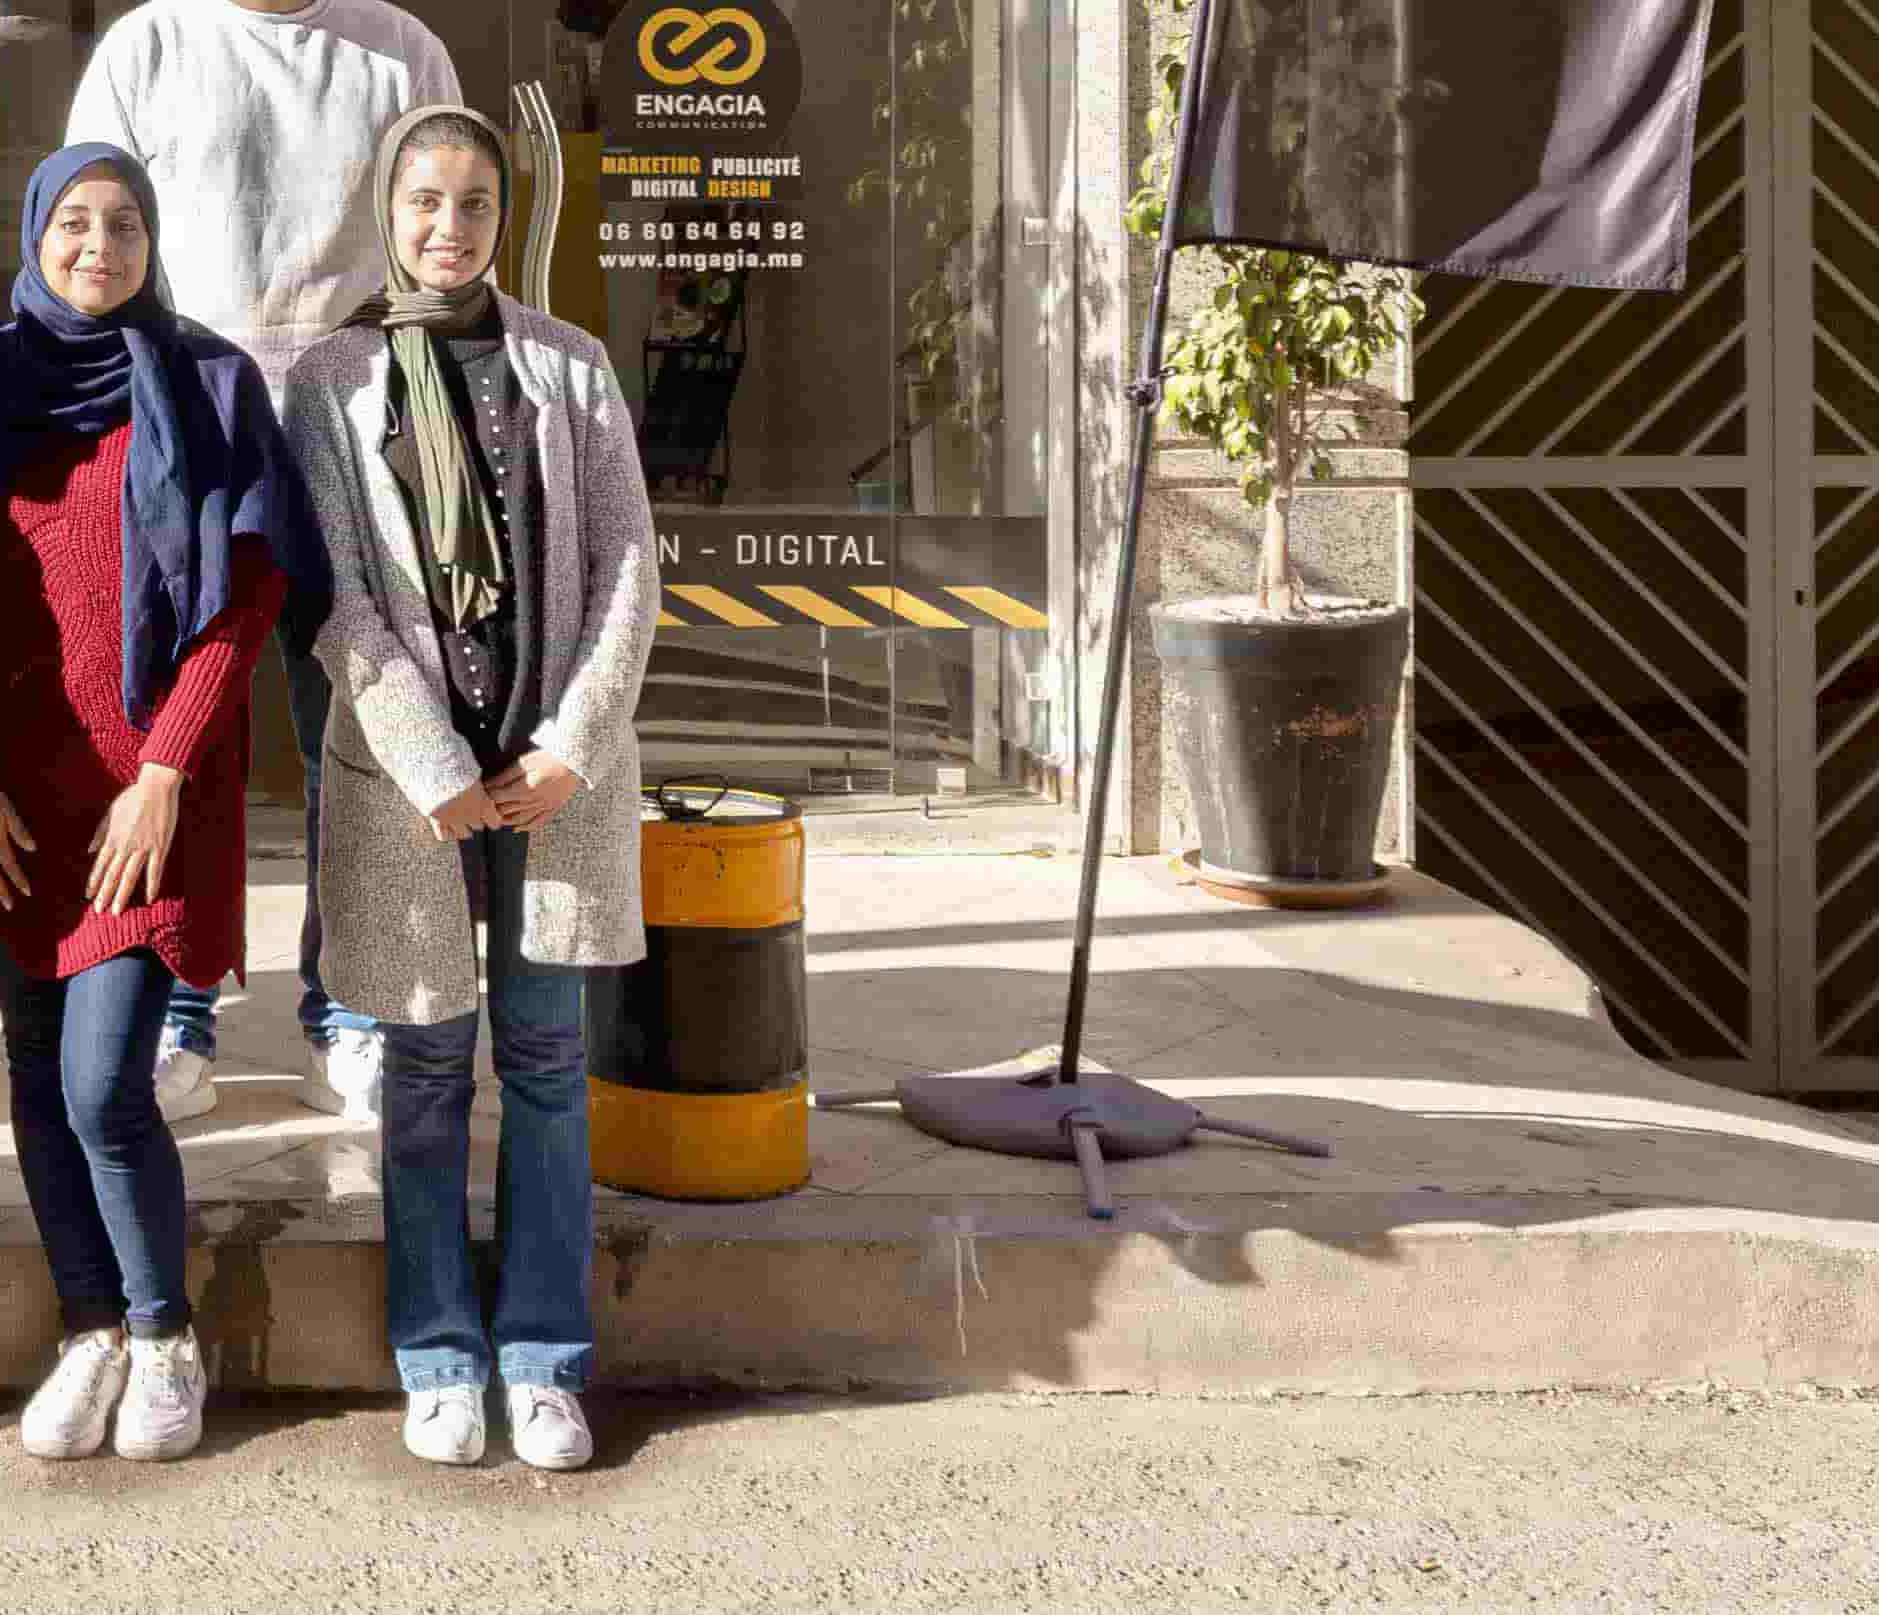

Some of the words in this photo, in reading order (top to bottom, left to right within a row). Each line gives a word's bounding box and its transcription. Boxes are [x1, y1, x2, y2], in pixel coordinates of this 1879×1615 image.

[636, 93, 766, 116] ENGAGIA
[601, 155, 701, 175] MARKETING
[712, 155, 801, 176] PUBLICITÉ
[631, 179, 698, 198] DIGITAL
[706, 179, 771, 198] DESIGN
[599, 222, 631, 241] 06
[772, 222, 804, 241] 92
[599, 249, 803, 272] www.engagia.ma
[736, 534, 886, 567] DIGITAL
